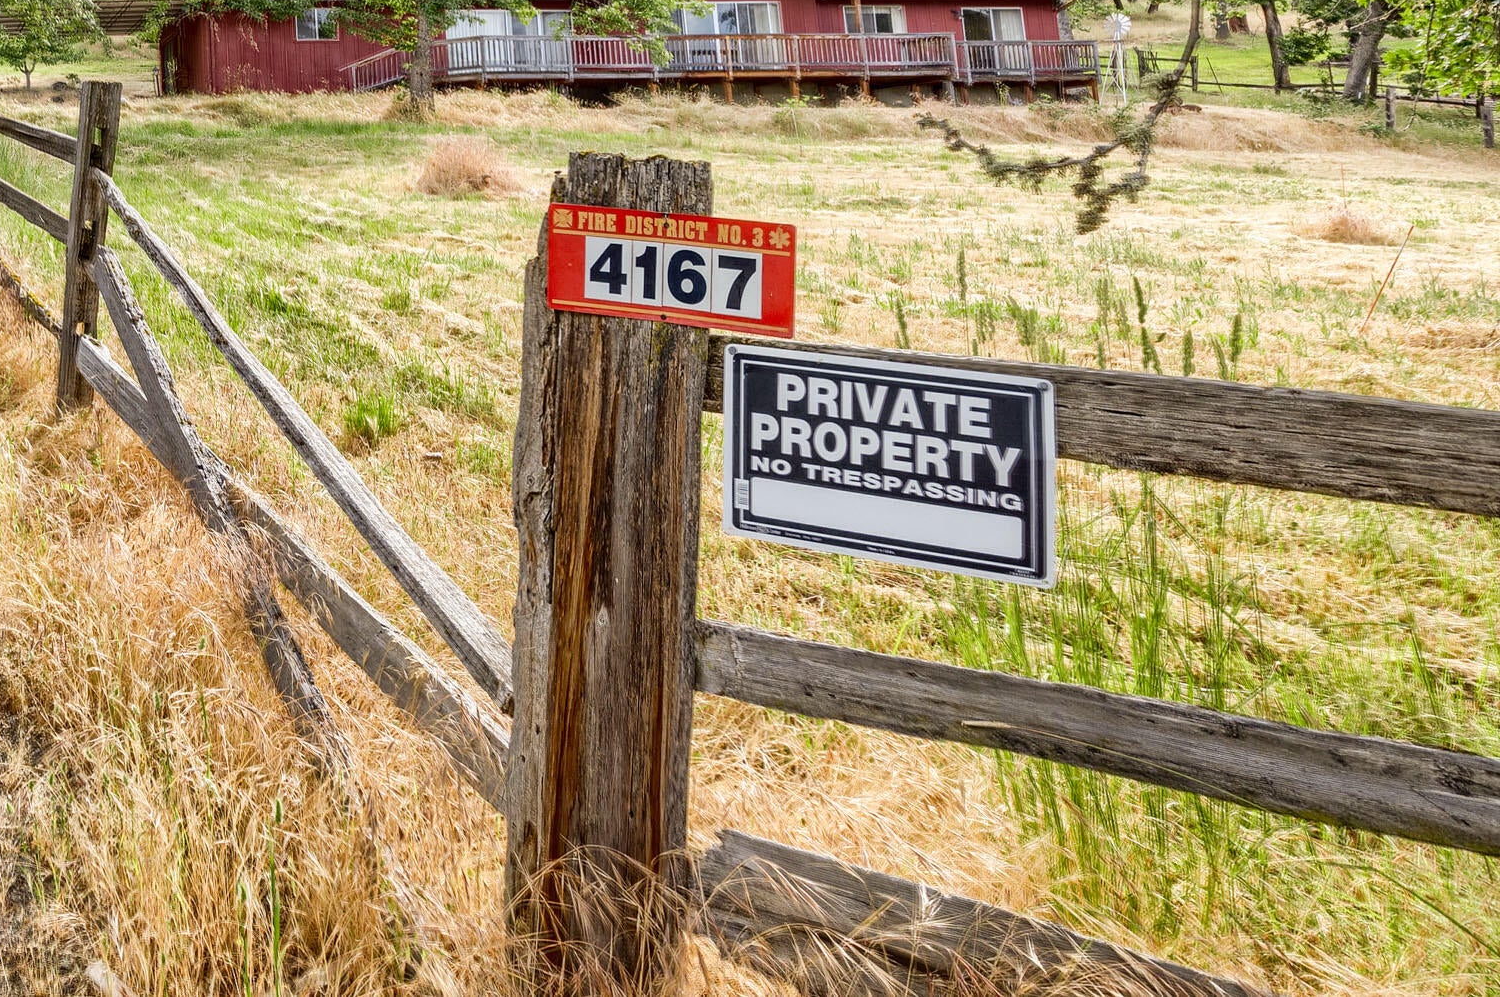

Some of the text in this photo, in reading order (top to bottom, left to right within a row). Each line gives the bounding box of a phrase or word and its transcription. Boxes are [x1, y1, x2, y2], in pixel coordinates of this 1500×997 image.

[578, 211, 764, 247] FIRE DISTRICT NO. 3
[589, 243, 757, 311] 4167
[776, 372, 992, 439] PRIVATE
[751, 412, 1021, 487] PROPERTY
[751, 455, 1023, 511] NO TRESPASSING
